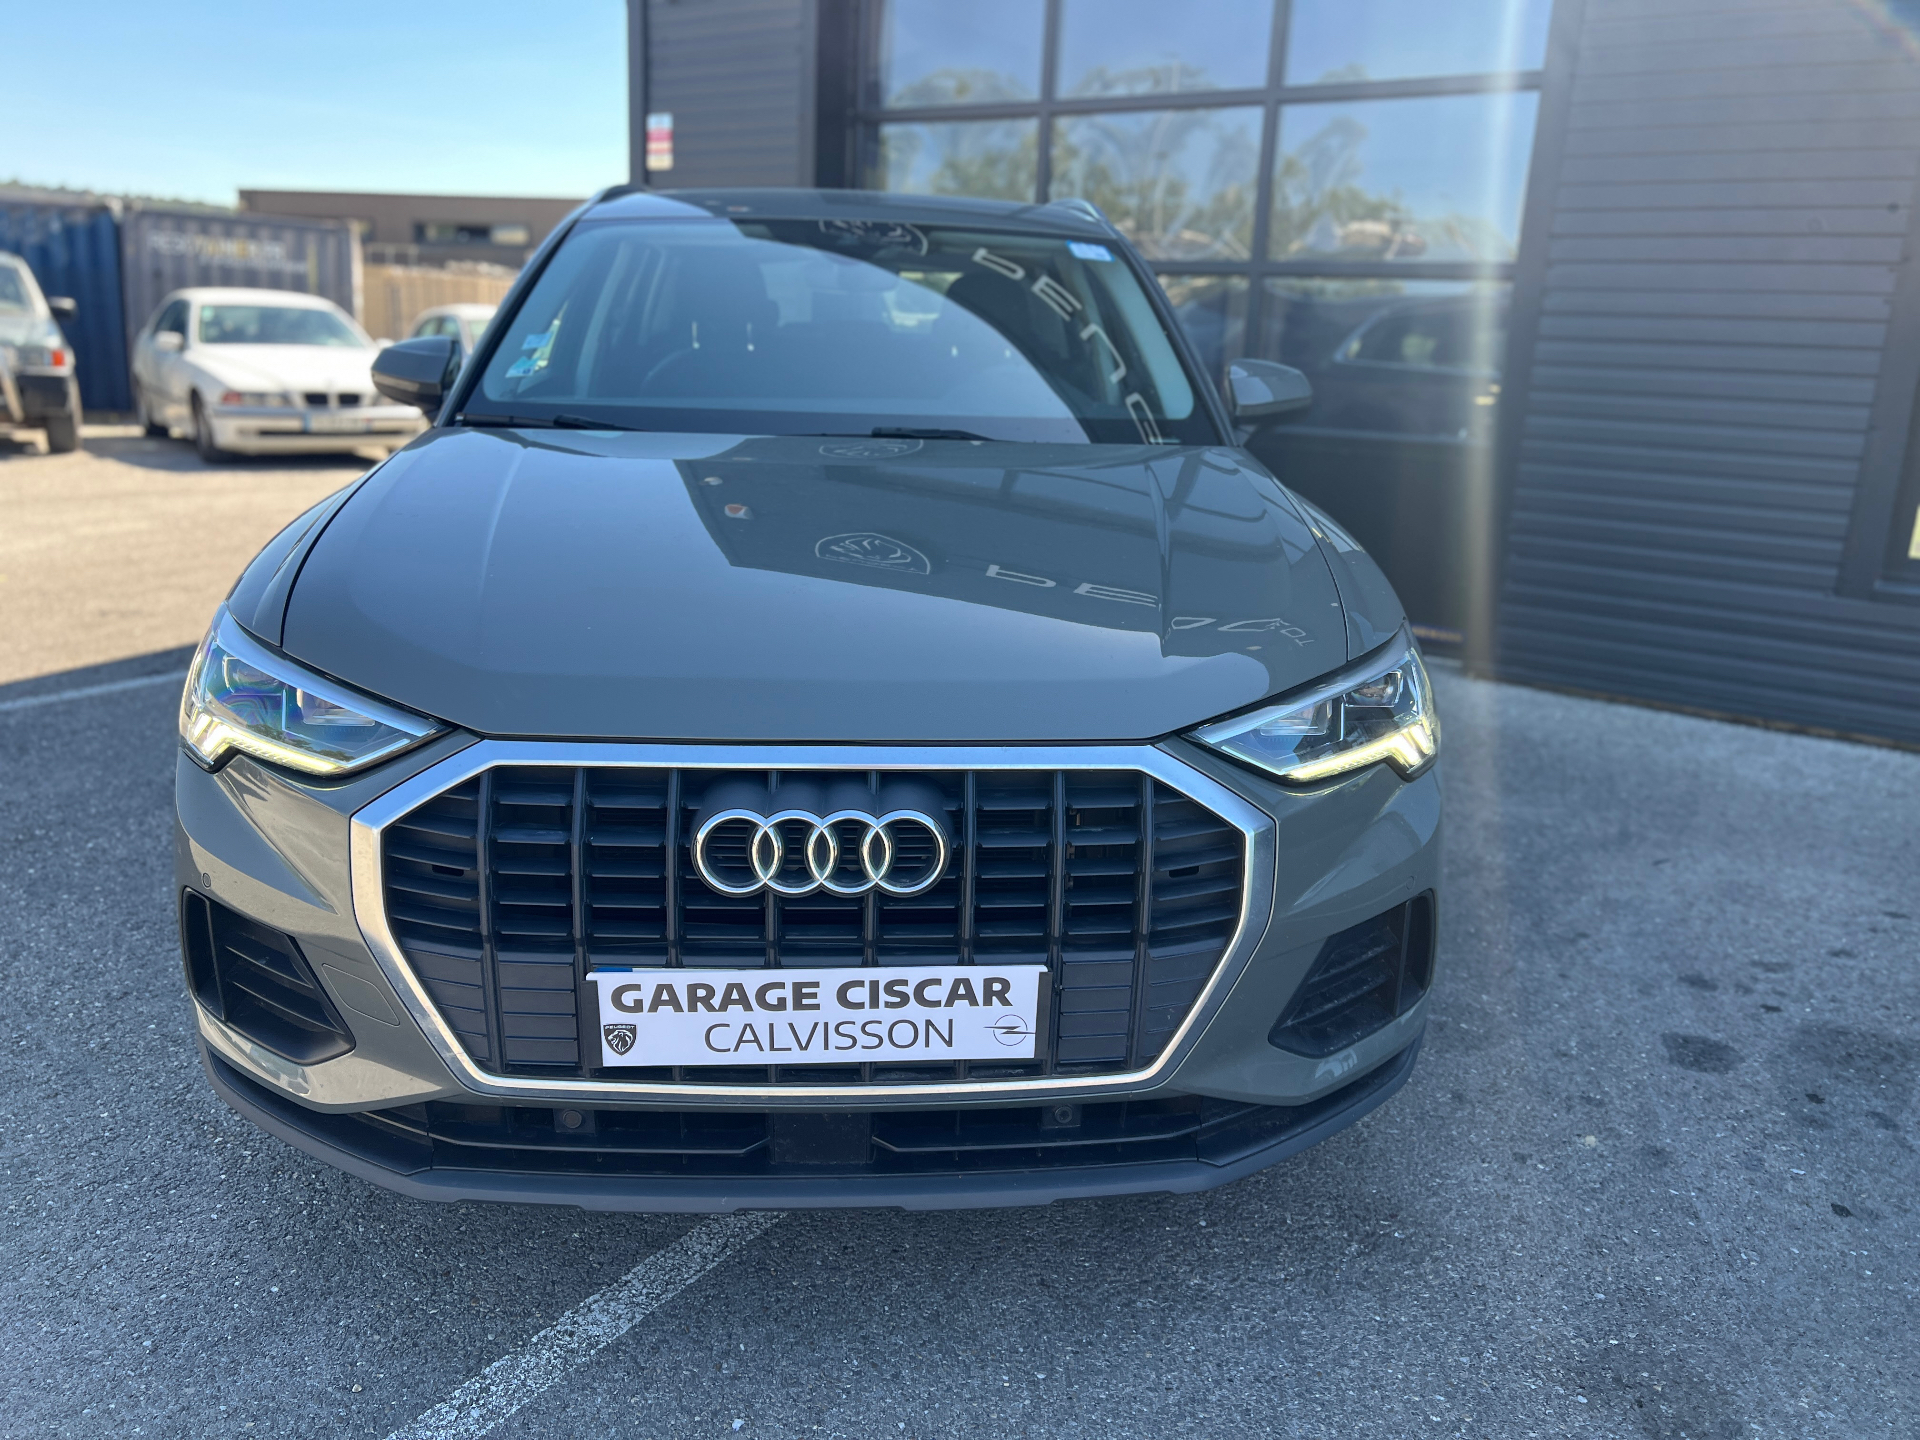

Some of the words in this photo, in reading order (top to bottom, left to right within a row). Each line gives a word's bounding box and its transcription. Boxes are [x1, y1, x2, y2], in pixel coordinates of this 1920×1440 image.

[610, 981, 821, 1014] GARAGE
[835, 976, 1014, 1010] CISCAR
[704, 1018, 954, 1053] CALVISSON
